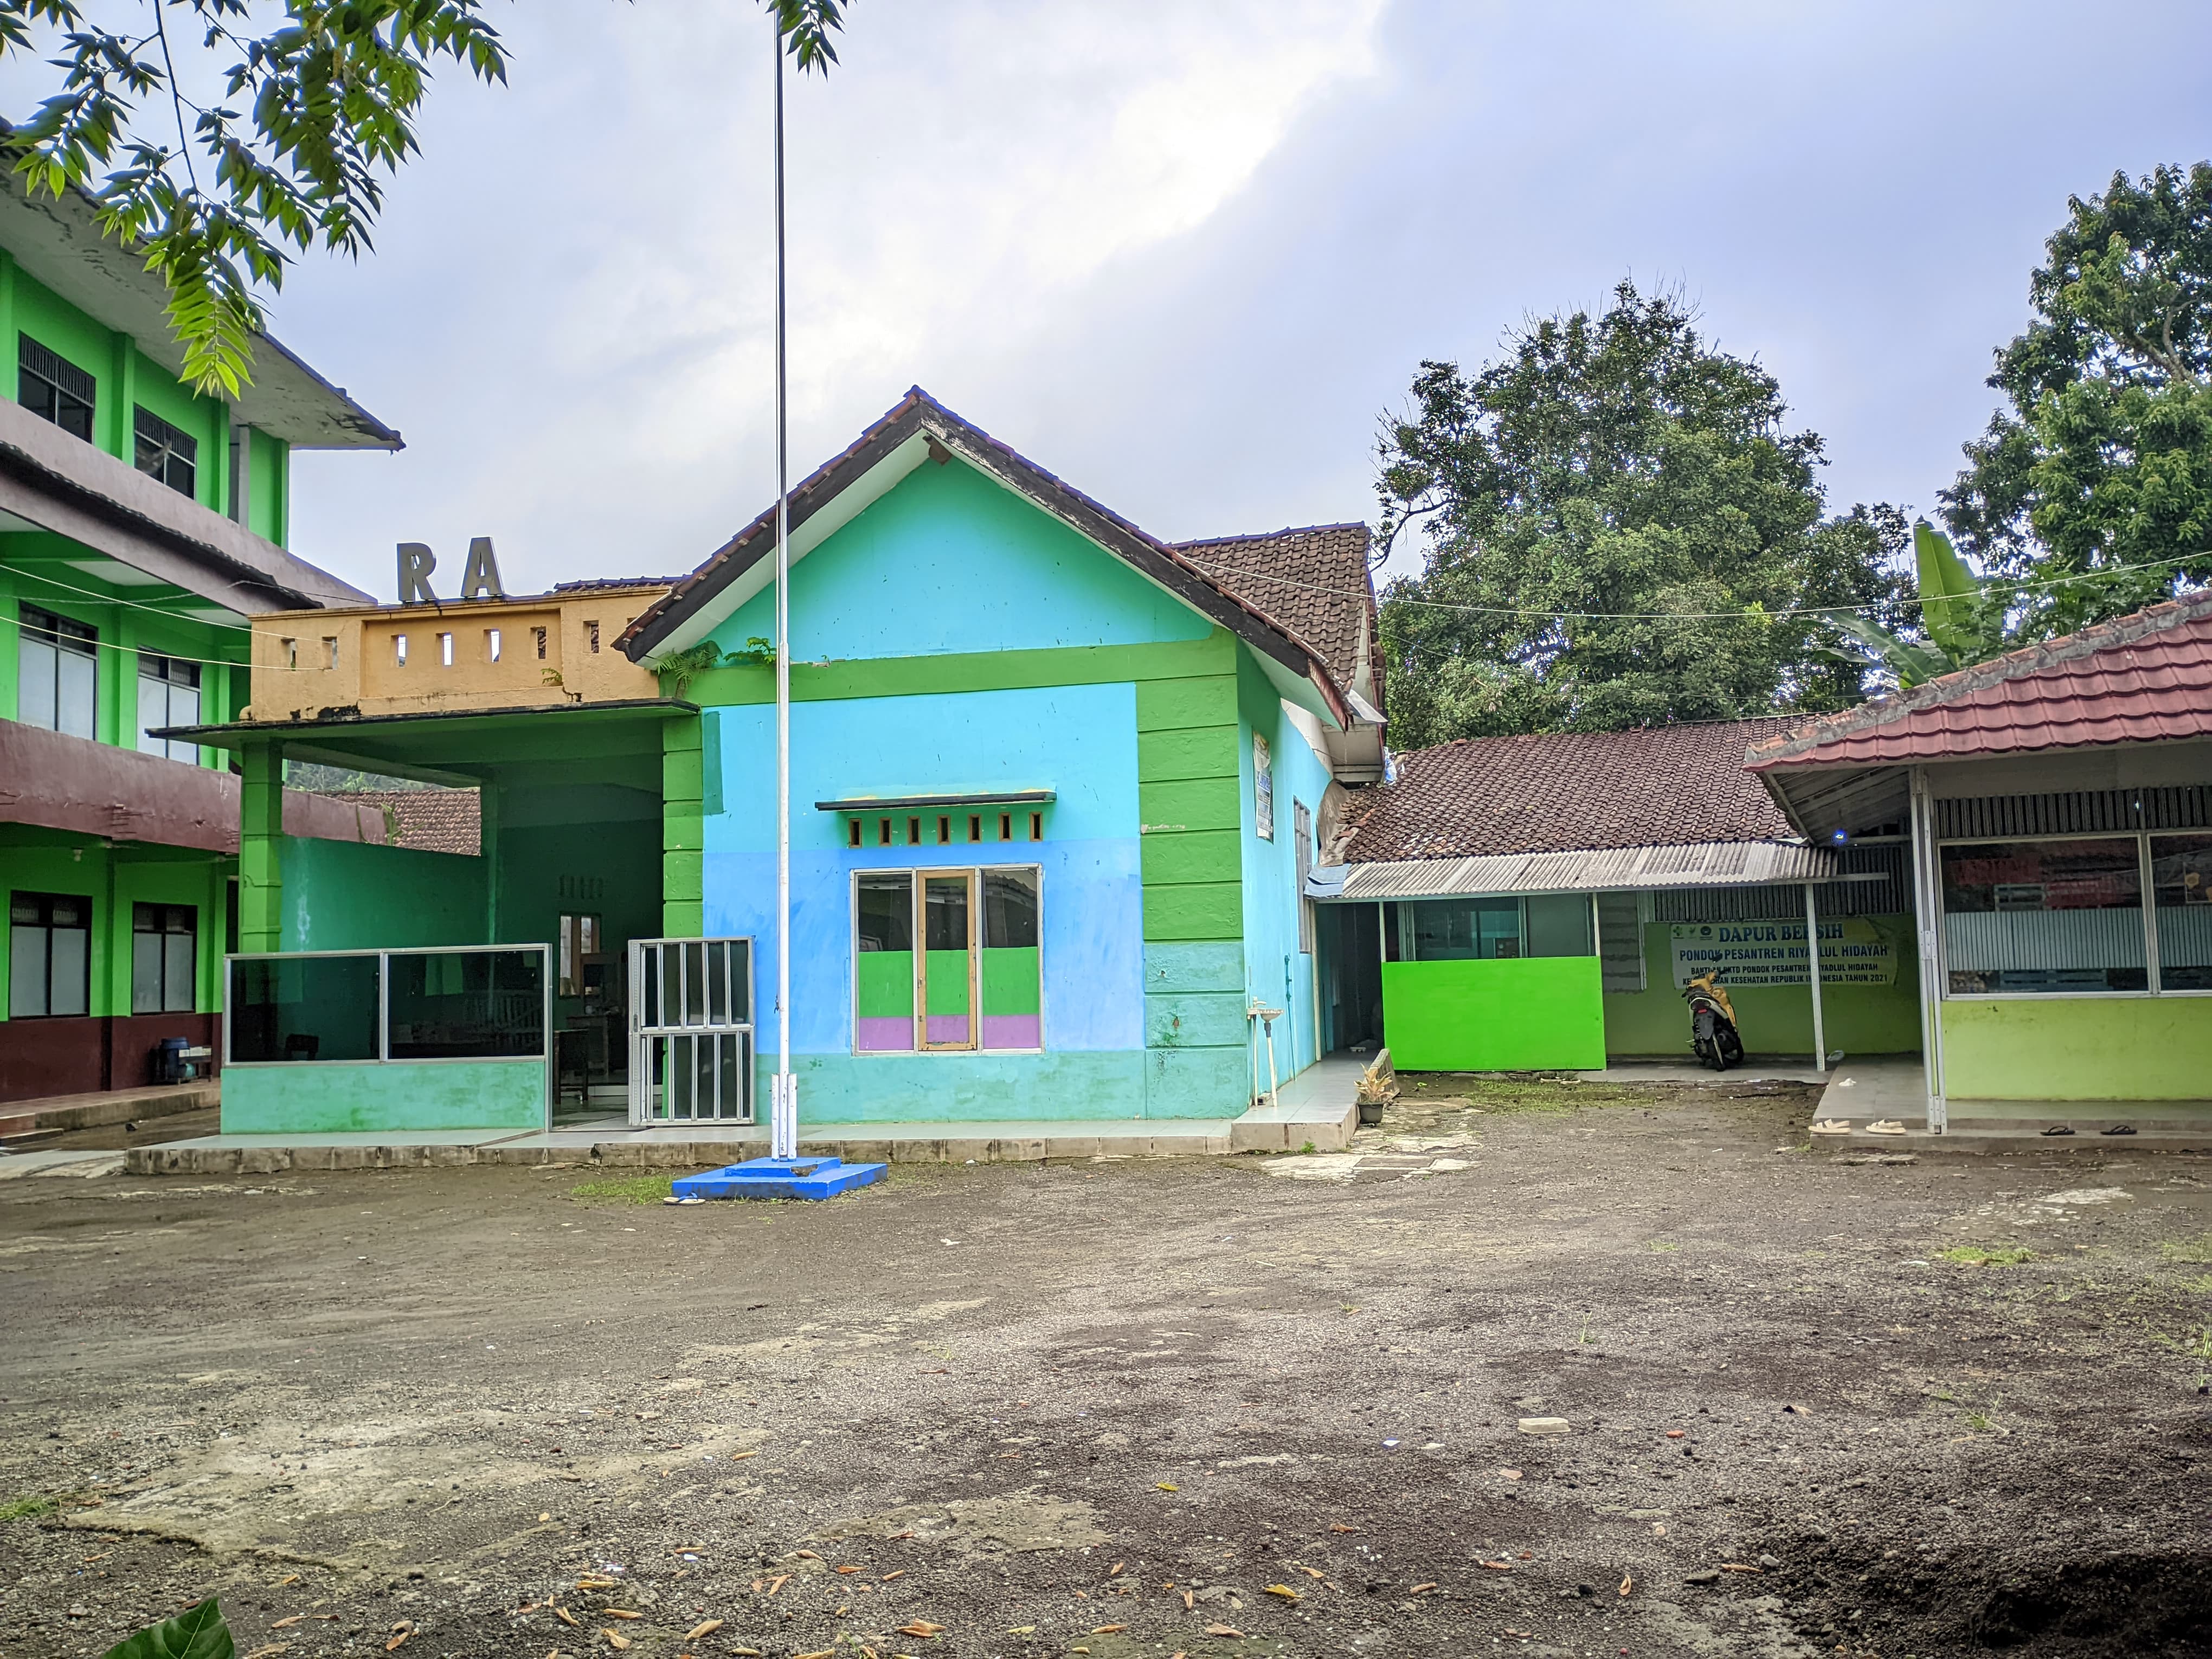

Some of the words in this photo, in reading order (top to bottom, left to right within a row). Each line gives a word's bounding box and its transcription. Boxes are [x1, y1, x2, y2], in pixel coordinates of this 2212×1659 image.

[396, 536, 504, 602] RA
[1719, 925, 1777, 942] DAPUR
[1724, 948, 1784, 960] PESANTREN
[1789, 946, 1838, 959] RIYALUL
[1842, 945, 1888, 957] HIDAYAH
[1742, 965, 1770, 974] PONDOK
[1772, 964, 1811, 973] PESANTREN
[1817, 963, 1846, 972] IYADLUL
[1848, 963, 1877, 972] HIDAYAH
[1731, 975, 1769, 984] KESEHATAN
[1771, 975, 1804, 983] REPUBLIK
[1806, 974, 1843, 982] INONESIA
[1846, 974, 1868, 982] TAHUN
[1870, 974, 1887, 982] 2021
